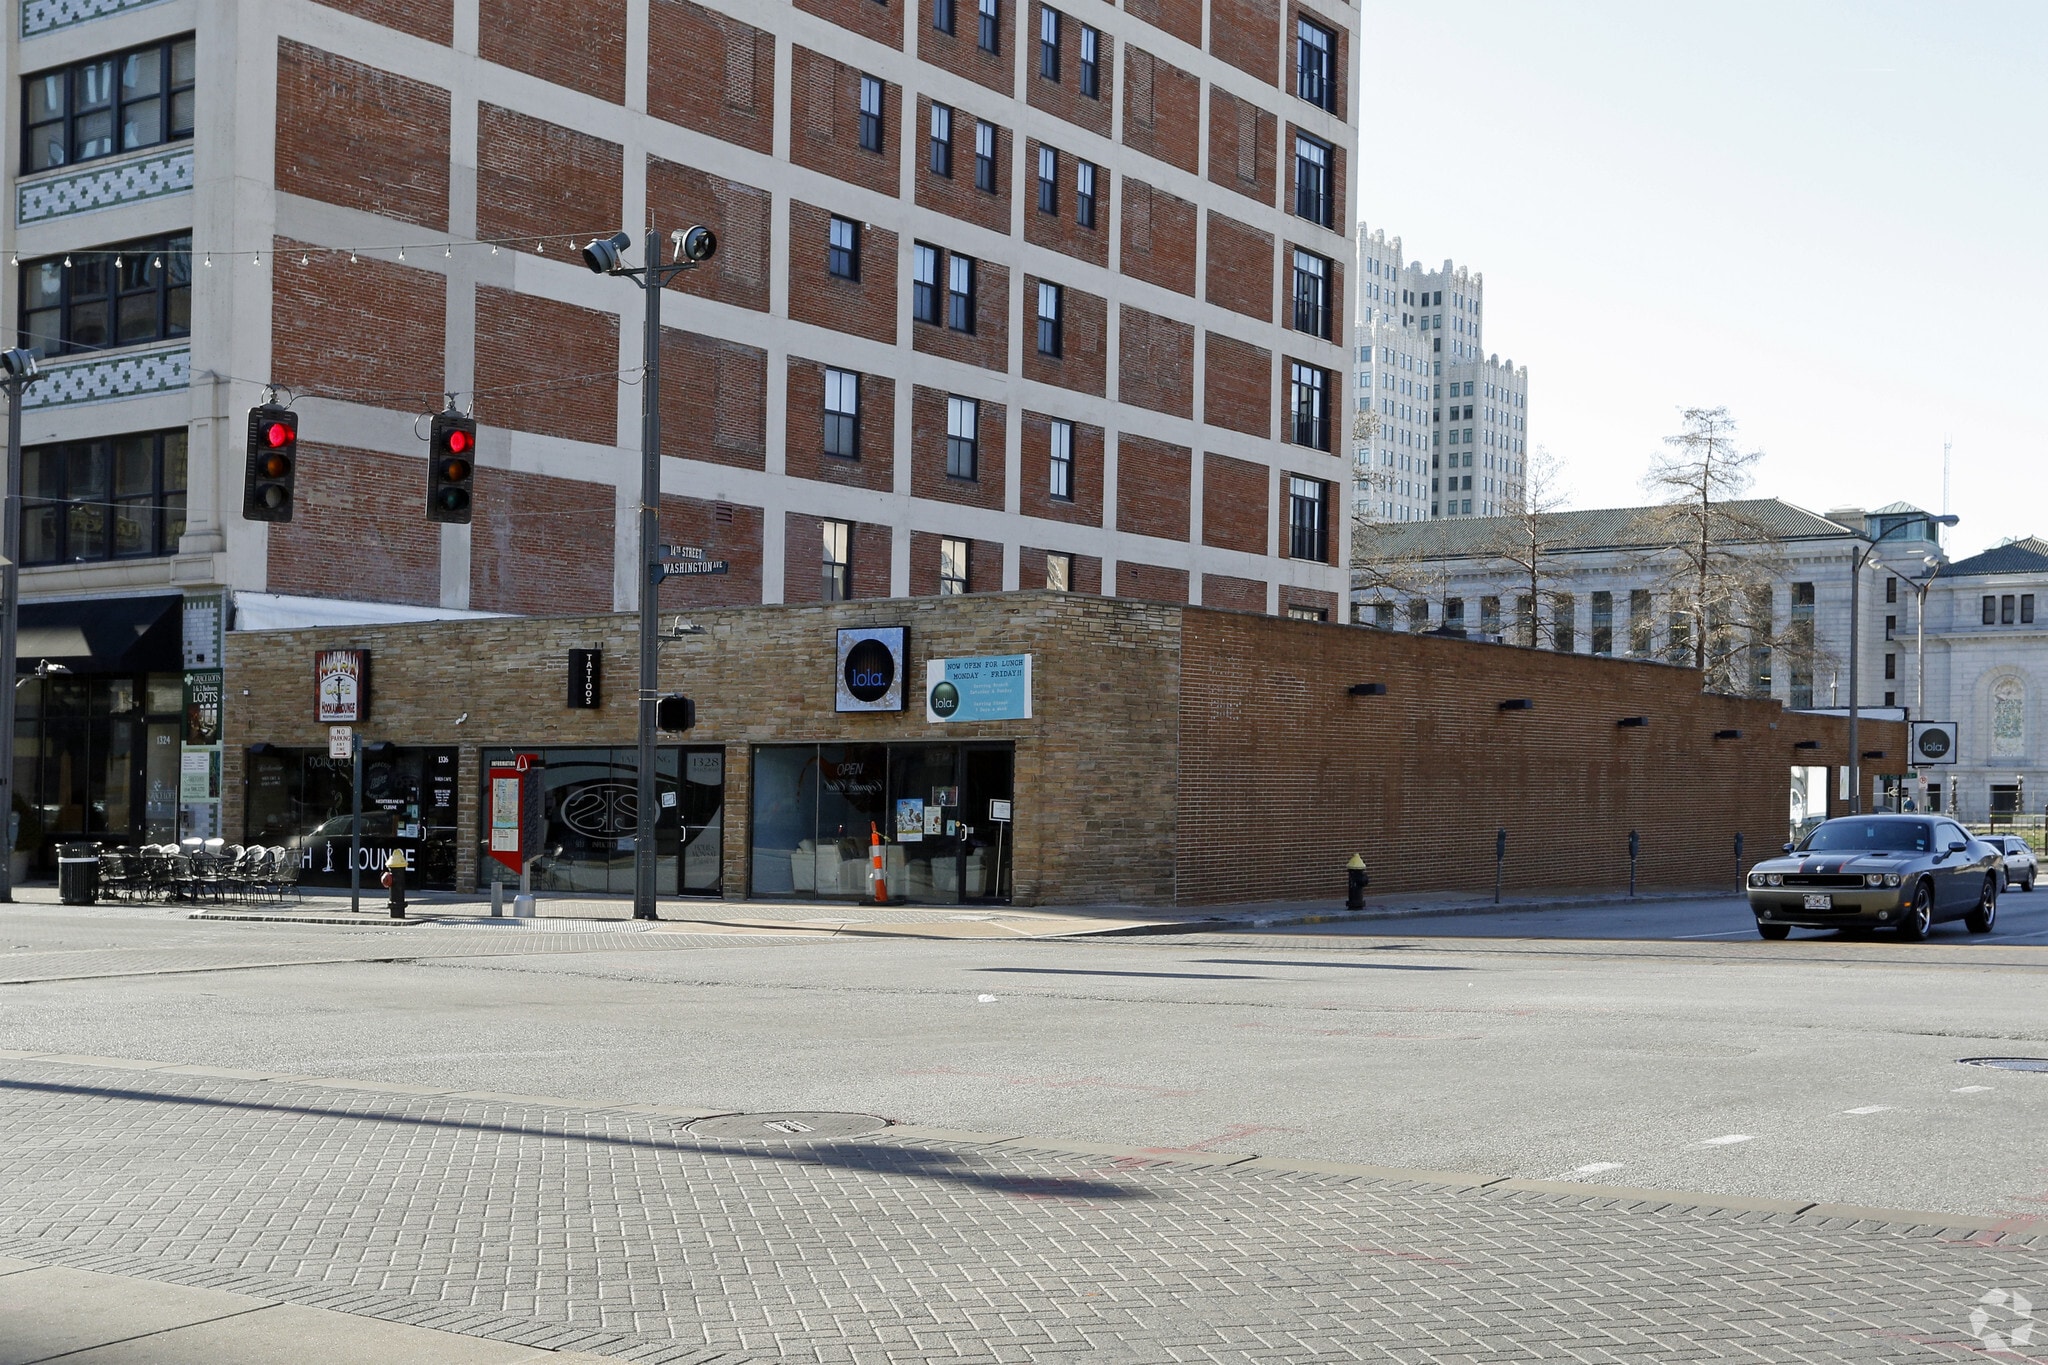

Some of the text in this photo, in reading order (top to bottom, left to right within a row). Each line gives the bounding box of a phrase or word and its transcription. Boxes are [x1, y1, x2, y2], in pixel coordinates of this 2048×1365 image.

[682, 547, 702, 559] STREET
[663, 561, 722, 574] WASHINGTON AVE
[985, 660, 998, 668] FOR
[1001, 659, 1023, 667] LUNCH
[852, 668, 886, 687] lola.
[953, 672, 979, 680] MONDAY
[990, 670, 1022, 678] FRIDAY!!
[193, 691, 218, 703] LOFTS
[935, 698, 955, 708] lola.
[157, 735, 171, 745] 1324
[1923, 742, 1945, 752] lola.
[693, 757, 719, 767] 1328
[837, 762, 864, 776] OPEN
